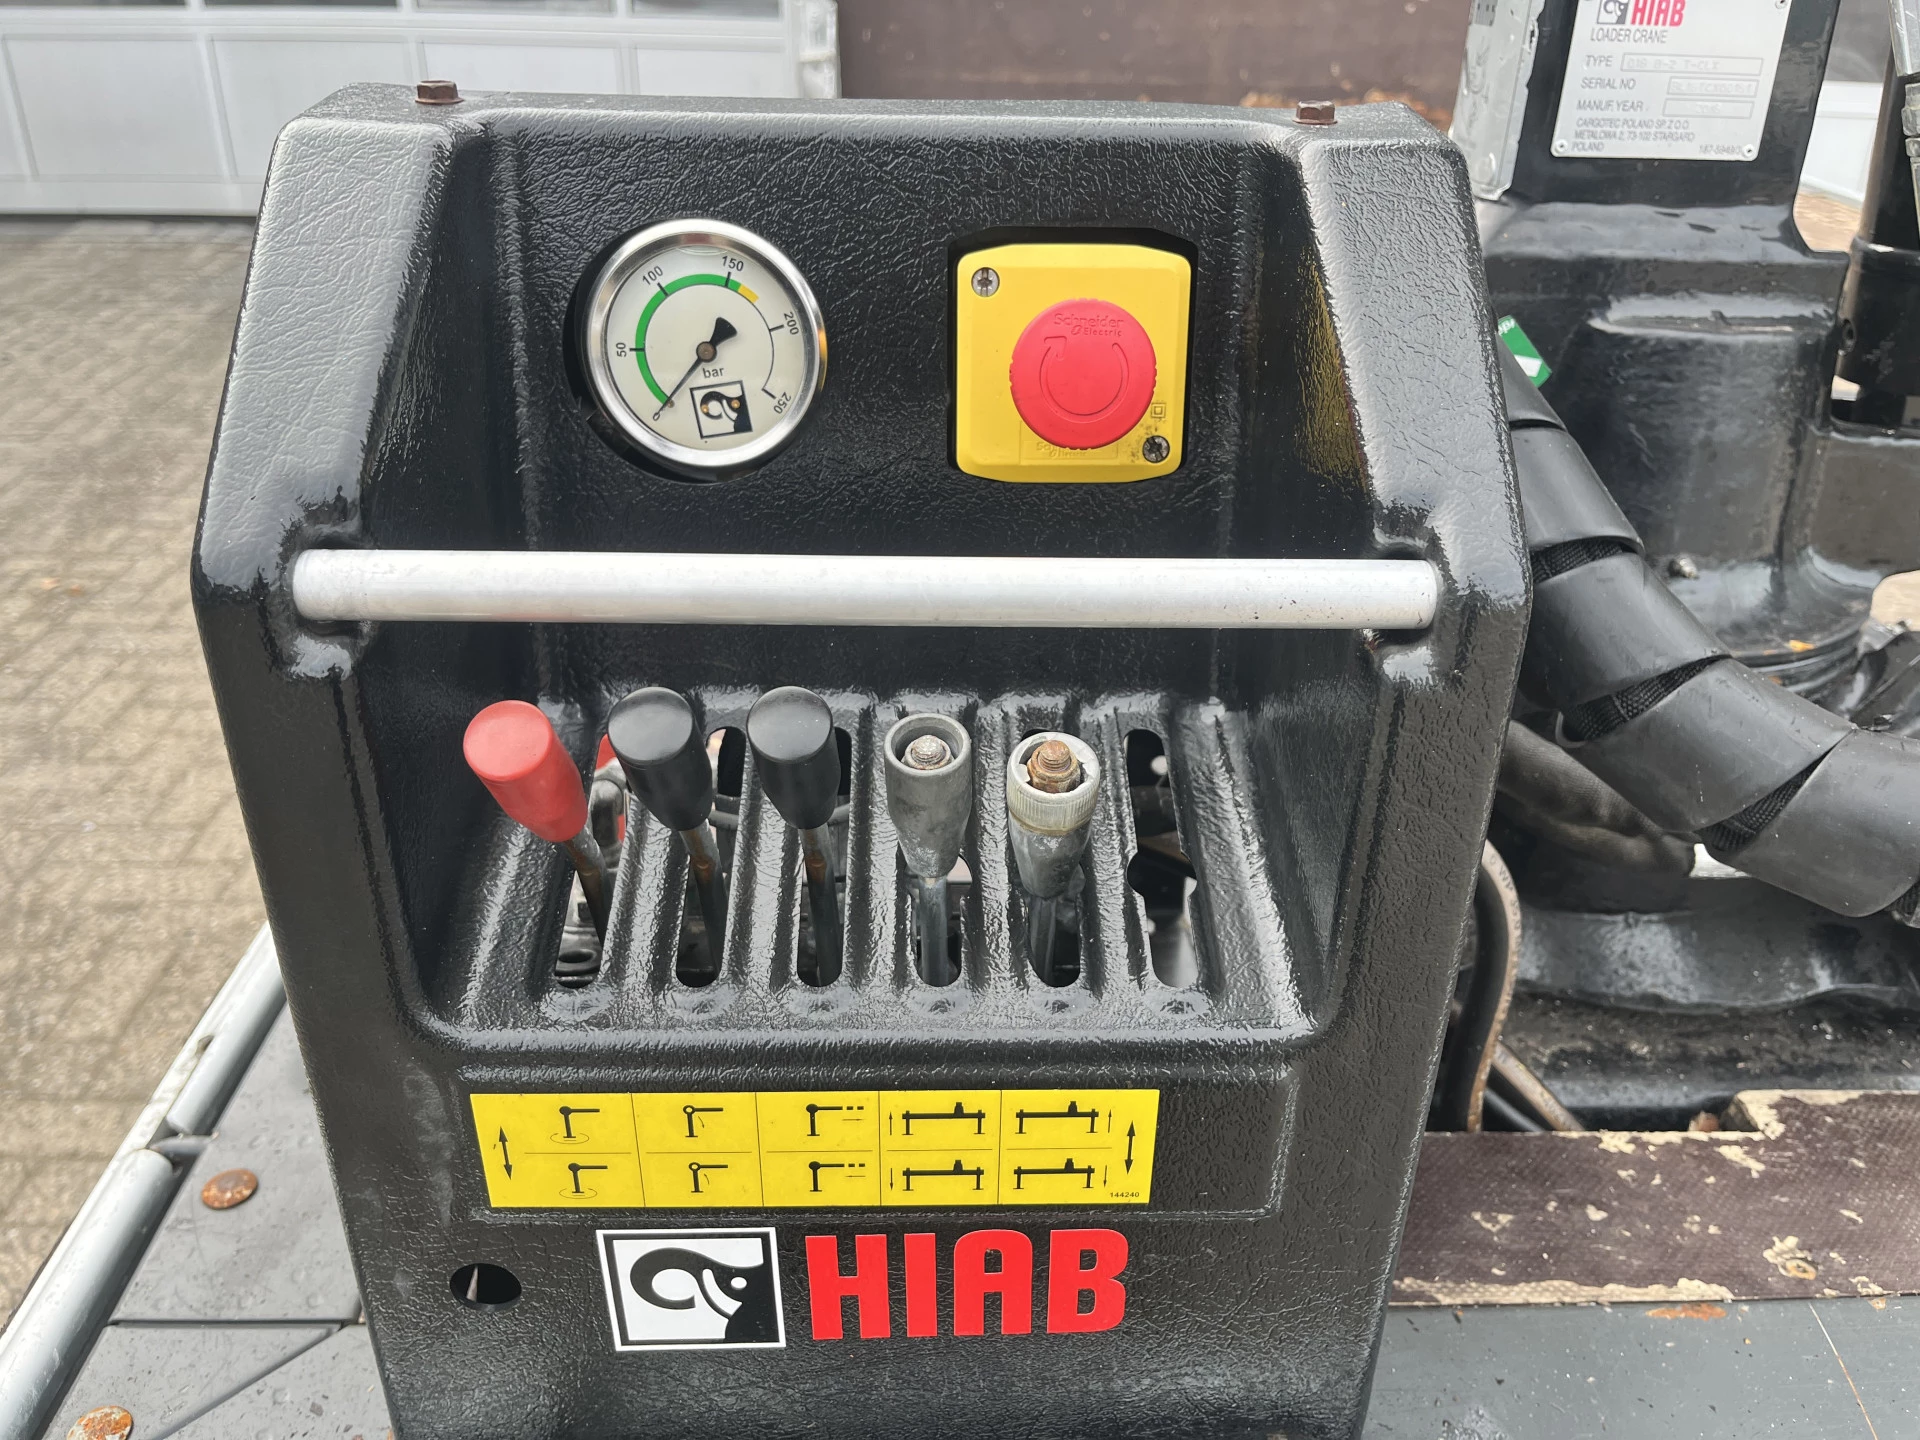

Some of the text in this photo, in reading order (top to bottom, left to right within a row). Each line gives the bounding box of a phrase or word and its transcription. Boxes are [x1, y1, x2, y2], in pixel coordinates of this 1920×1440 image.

[1630, 0, 1686, 26] HIAB
[1590, 28, 1668, 44] LOADER CRANE
[1585, 55, 1613, 67] TYPE
[1580, 77, 1637, 90] SERIAL NO
[1616, 100, 1644, 112] YEAR
[1576, 117, 1621, 129] CARGOTEC
[1622, 118, 1654, 129] POLAND
[1571, 141, 1605, 152] POLAND
[721, 255, 744, 272] 150
[641, 265, 664, 286] 100
[783, 311, 800, 336] 200
[1053, 312, 1125, 328] Schneider
[1083, 328, 1123, 337] Electric
[615, 342, 627, 358] 50
[702, 366, 725, 379] bar
[773, 391, 792, 415] 250
[805, 1229, 1129, 1341] HIAB
